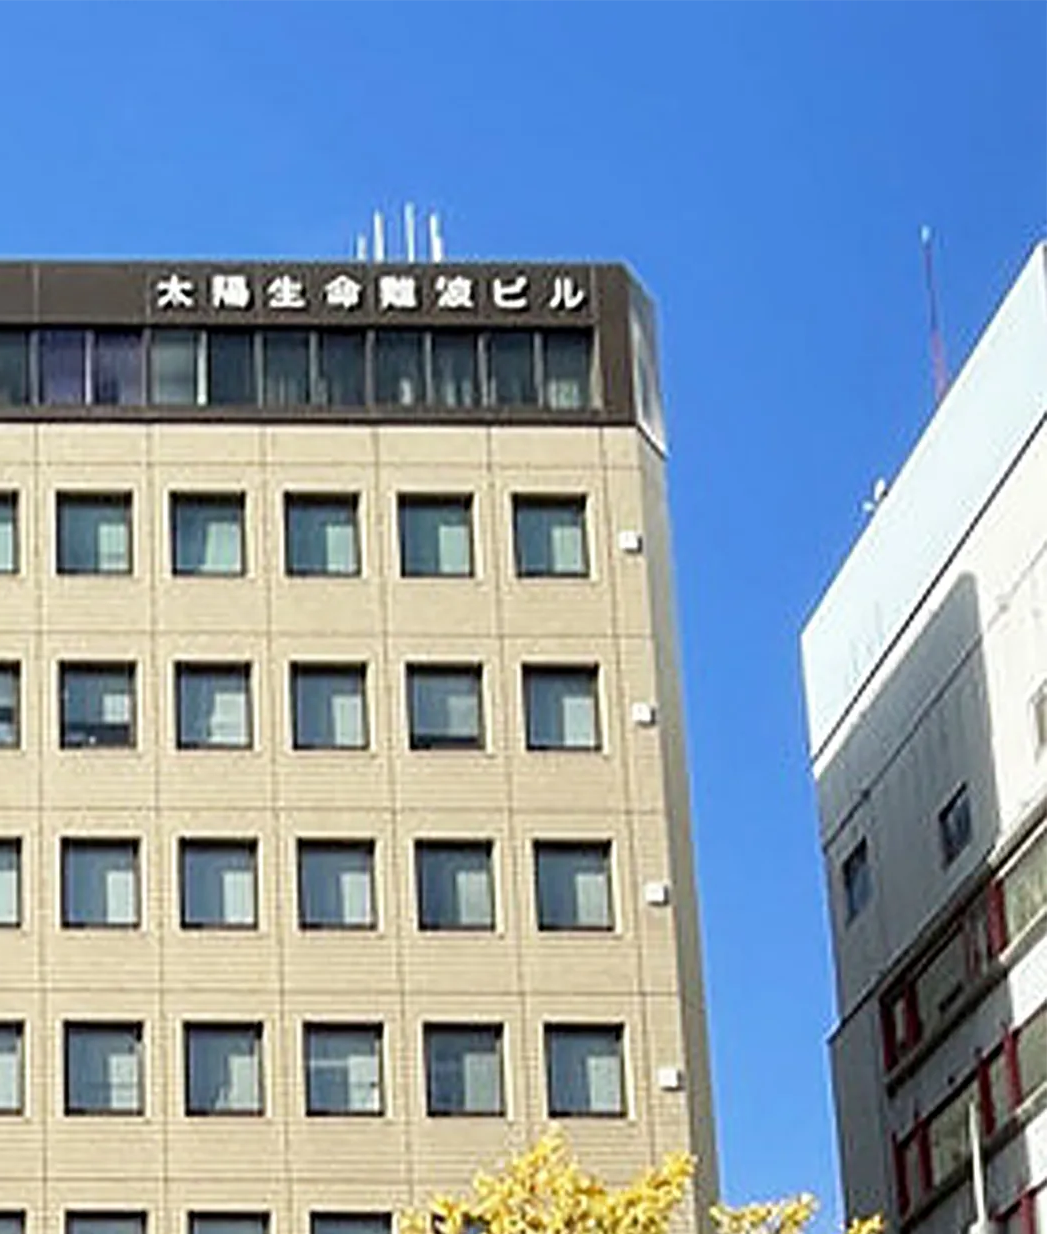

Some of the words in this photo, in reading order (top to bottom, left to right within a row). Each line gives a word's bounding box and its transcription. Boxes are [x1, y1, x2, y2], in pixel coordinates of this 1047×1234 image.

[156, 274, 584, 309] 太陽生命難波ビル
